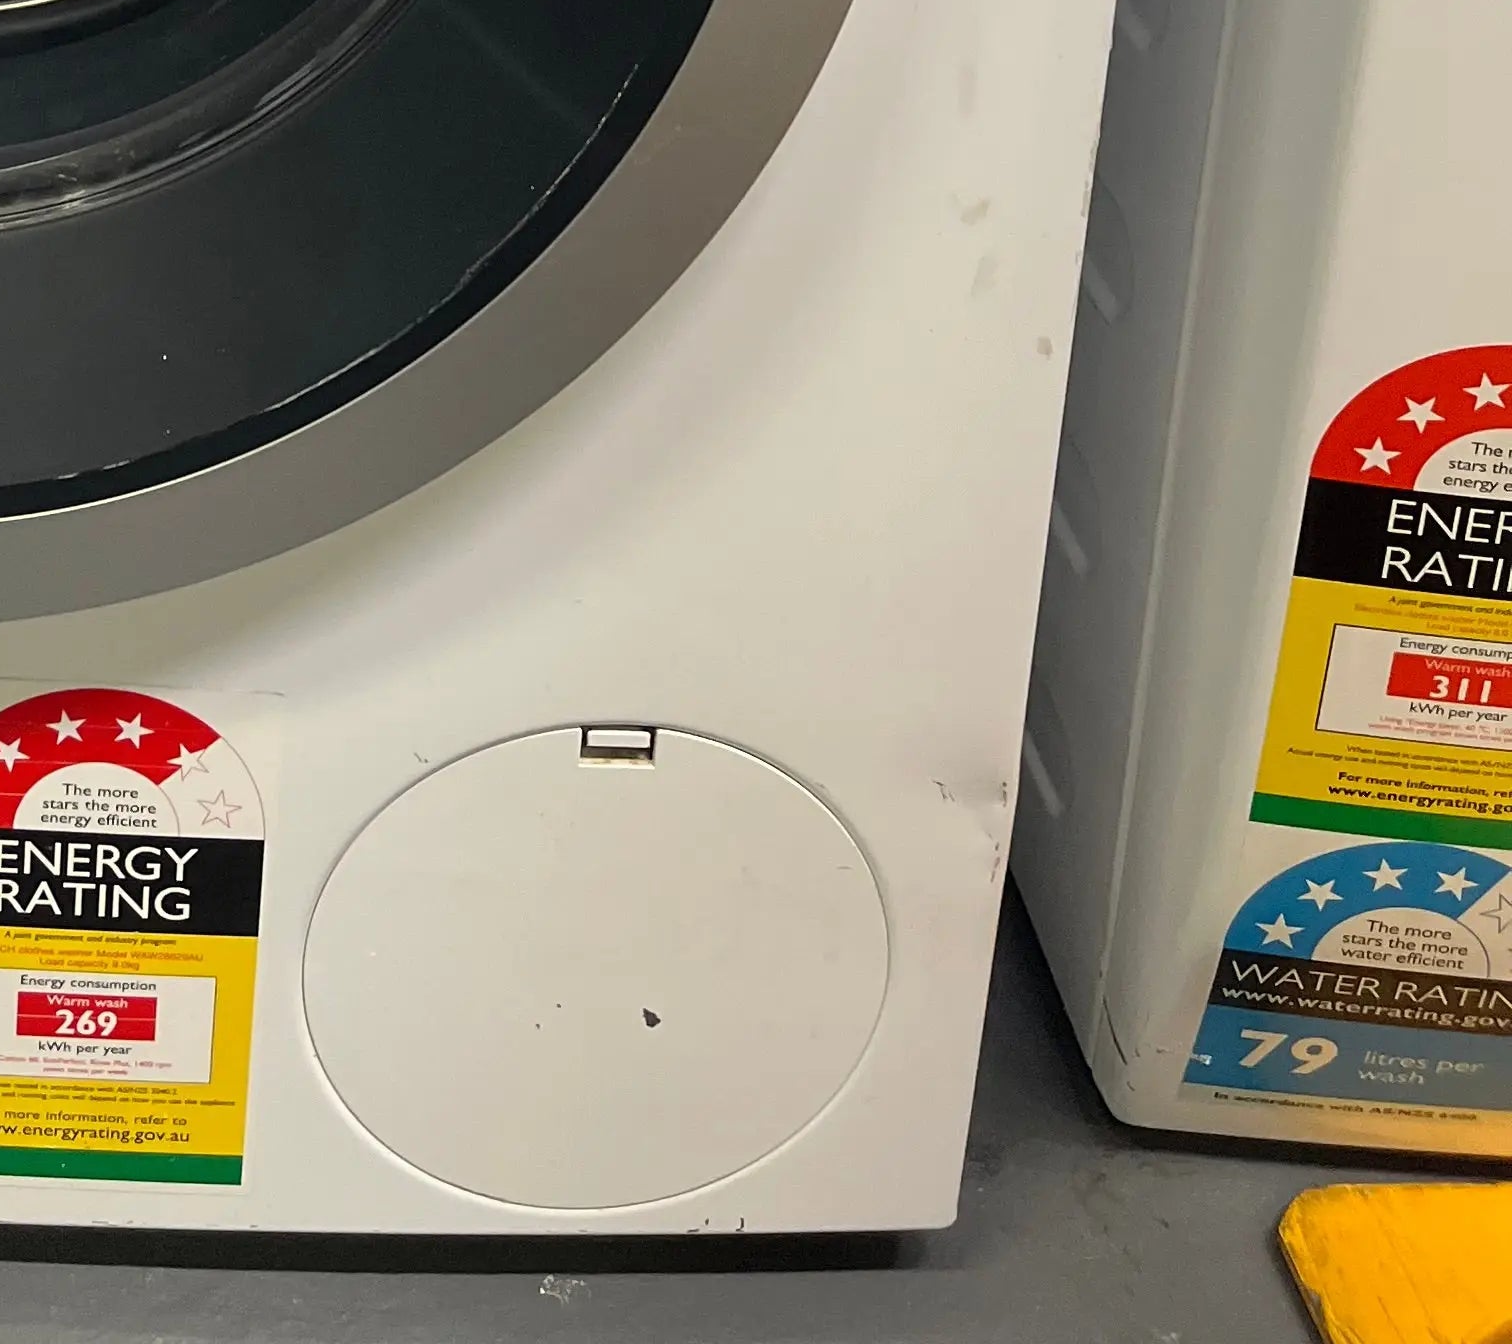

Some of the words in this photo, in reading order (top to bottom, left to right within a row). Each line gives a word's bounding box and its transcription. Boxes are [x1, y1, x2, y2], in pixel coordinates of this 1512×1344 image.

[1470, 440, 1504, 458] The
[1447, 459, 1488, 474] stars
[1442, 475, 1499, 494] energy
[1380, 545, 1512, 595] RATI
[1399, 636, 1449, 655] Energy
[1423, 656, 1472, 675] Warm
[1475, 663, 1511, 679] wash
[1429, 674, 1493, 704] 311
[1408, 700, 1445, 717] kWh
[1448, 707, 1474, 723] per
[1475, 709, 1509, 724] year
[1337, 770, 1363, 784] For
[1364, 775, 1403, 790] more
[61, 782, 92, 798] The
[97, 787, 140, 800] more
[41, 798, 80, 812] stars
[84, 799, 110, 813] the
[114, 802, 158, 815] more
[39, 813, 92, 829] energy
[96, 813, 158, 830] efficient
[1366, 918, 1400, 935] The
[1404, 924, 1453, 940] more
[1342, 932, 1384, 949] stars
[1387, 936, 1417, 953] the
[1421, 940, 1469, 957] more
[1340, 946, 1393, 963] water
[1395, 949, 1465, 970] efficient
[19, 974, 67, 991] Energy
[69, 977, 158, 994] consumption
[1231, 959, 1381, 1000] WATER
[45, 993, 90, 1009] Warm
[93, 996, 129, 1010] wash
[54, 1009, 119, 1037] 269
[37, 1040, 72, 1055] kWh
[76, 1043, 100, 1057] per
[102, 1044, 133, 1057] year
[1240, 1028, 1339, 1076] 79
[1363, 1050, 1428, 1071] litres
[1435, 1059, 1486, 1076] per
[1357, 1068, 1426, 1086] wash
[4, 1110, 41, 1122] more
[44, 1110, 129, 1125] information,
[133, 1114, 169, 1126] refer
[171, 1115, 188, 1127] to
